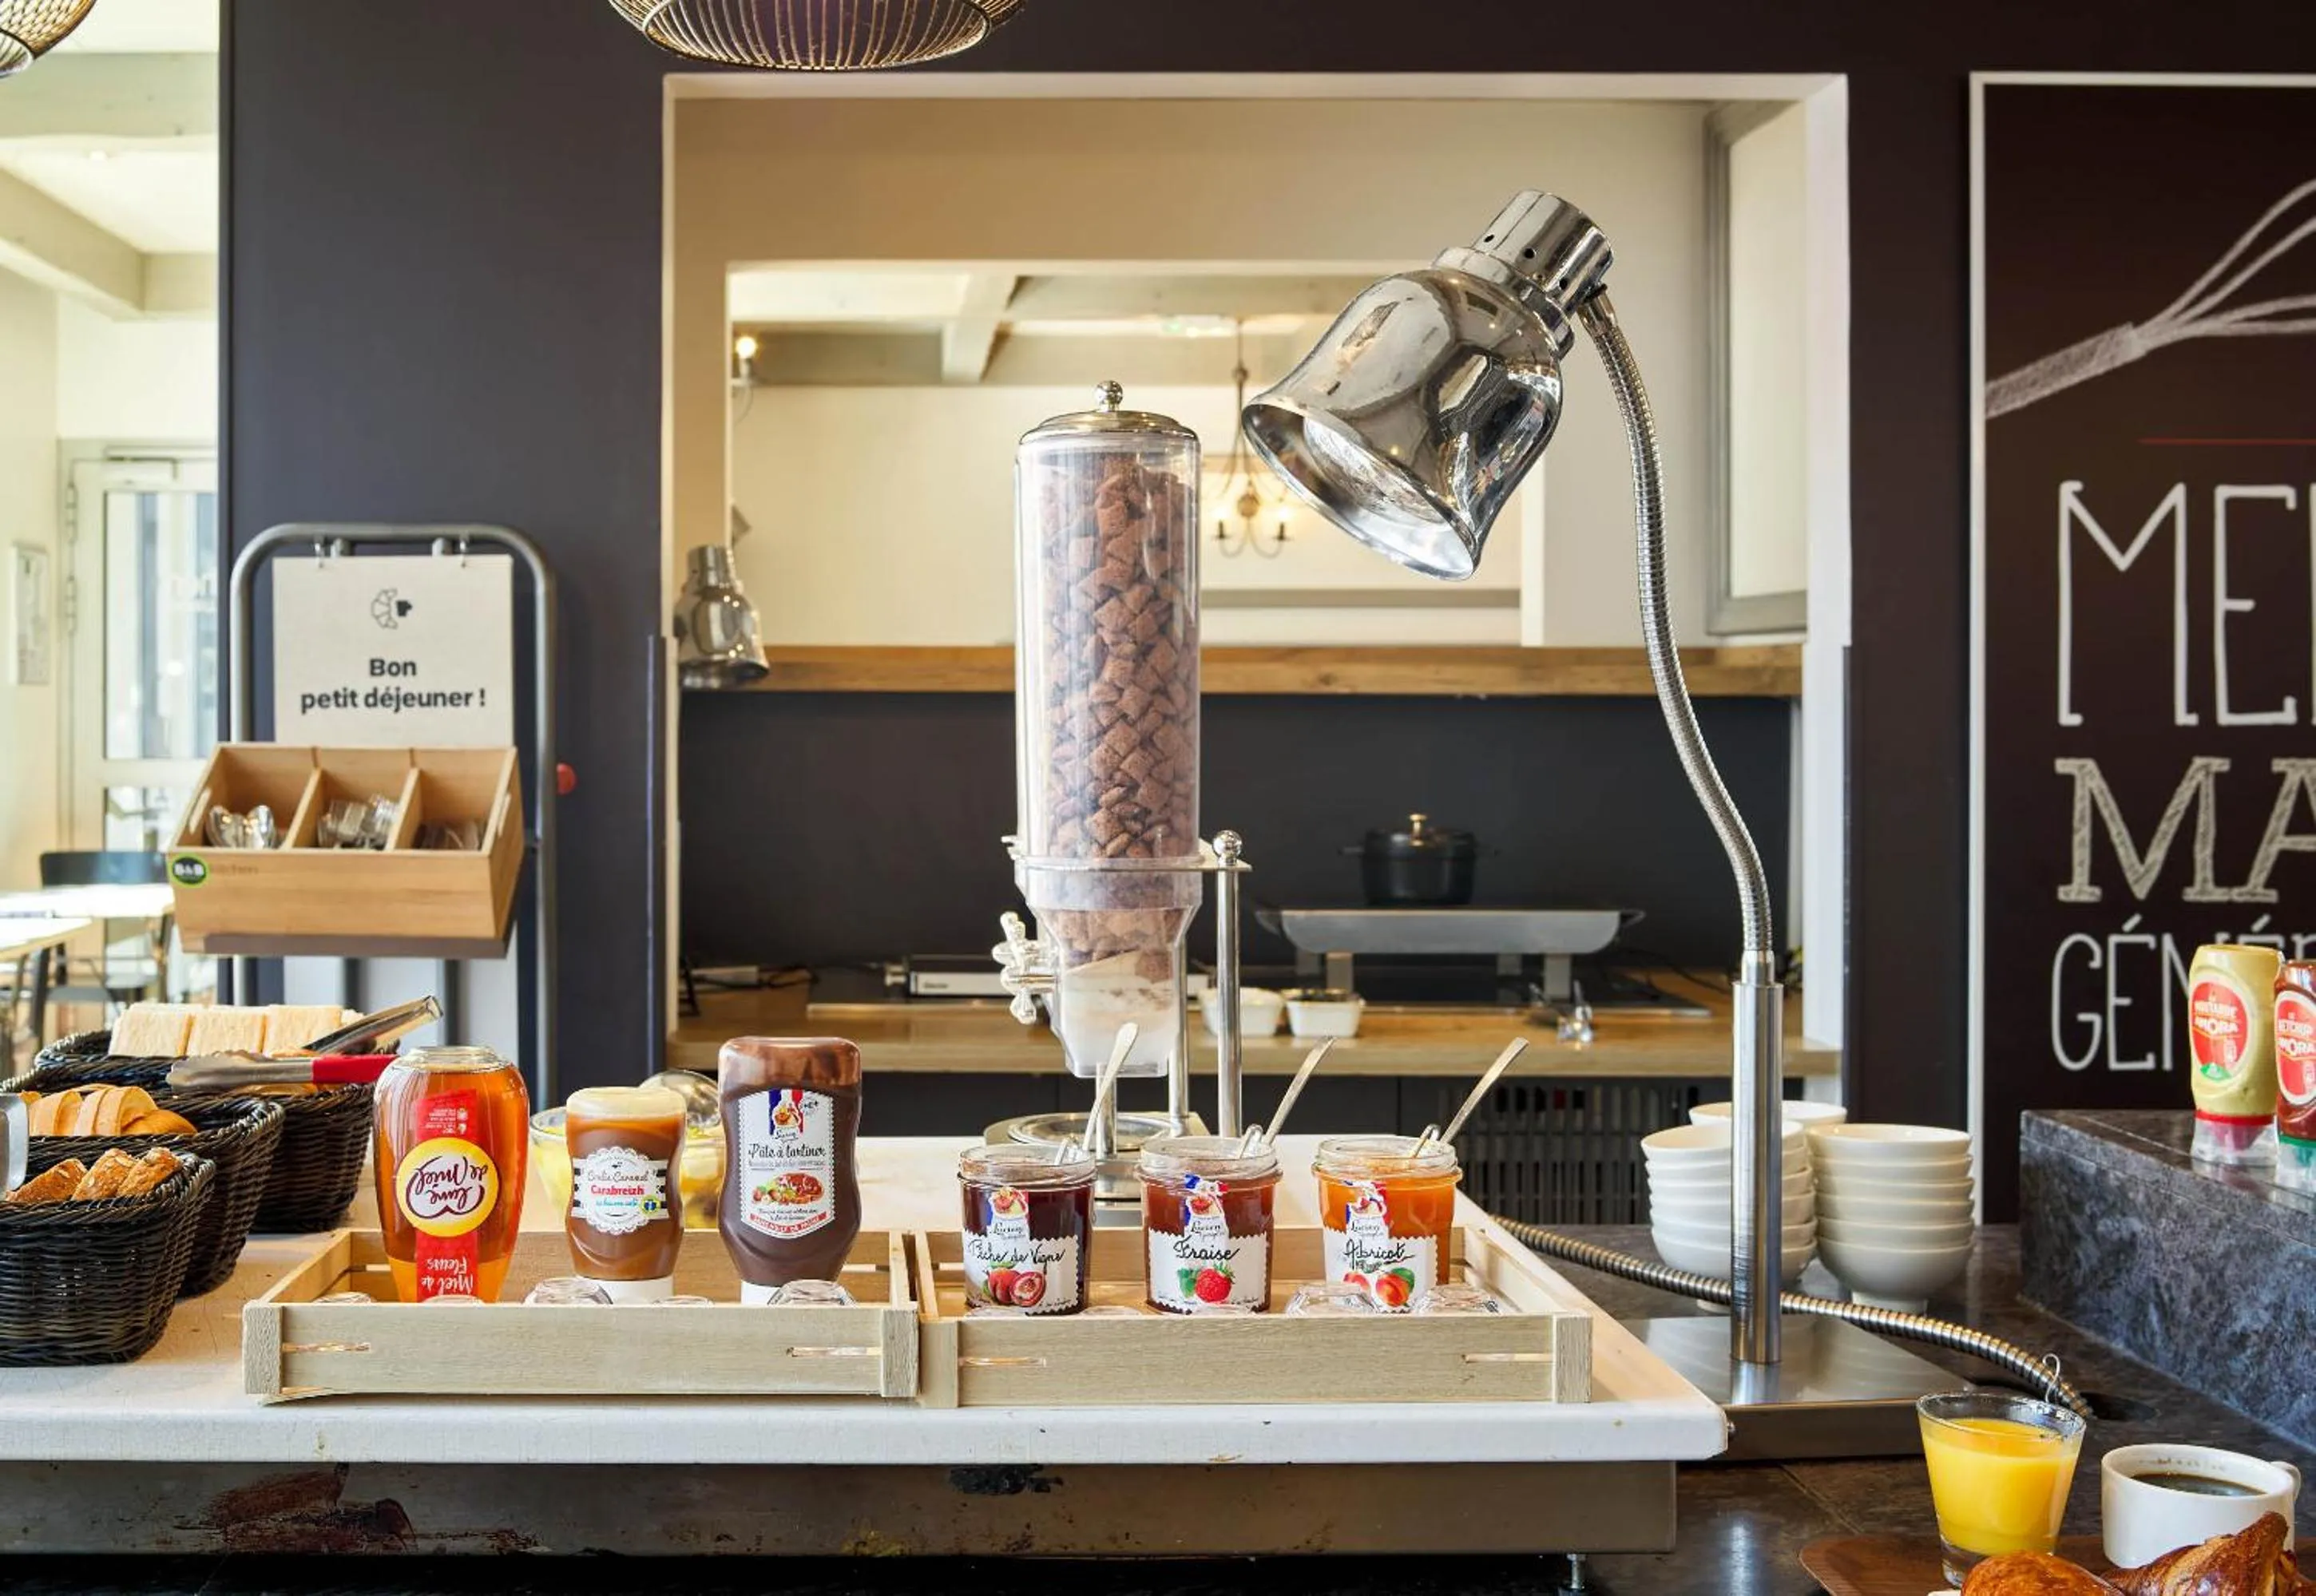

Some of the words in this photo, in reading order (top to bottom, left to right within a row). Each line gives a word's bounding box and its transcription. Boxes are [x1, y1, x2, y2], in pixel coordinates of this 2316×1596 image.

[2058, 481, 2316, 726] ME
[369, 658, 417, 677] Bon
[301, 687, 358, 715] petit
[364, 686, 473, 713] déjeuner
[1173, 1235, 1240, 1260] Fraise
[1344, 1238, 1414, 1270] Abricot
